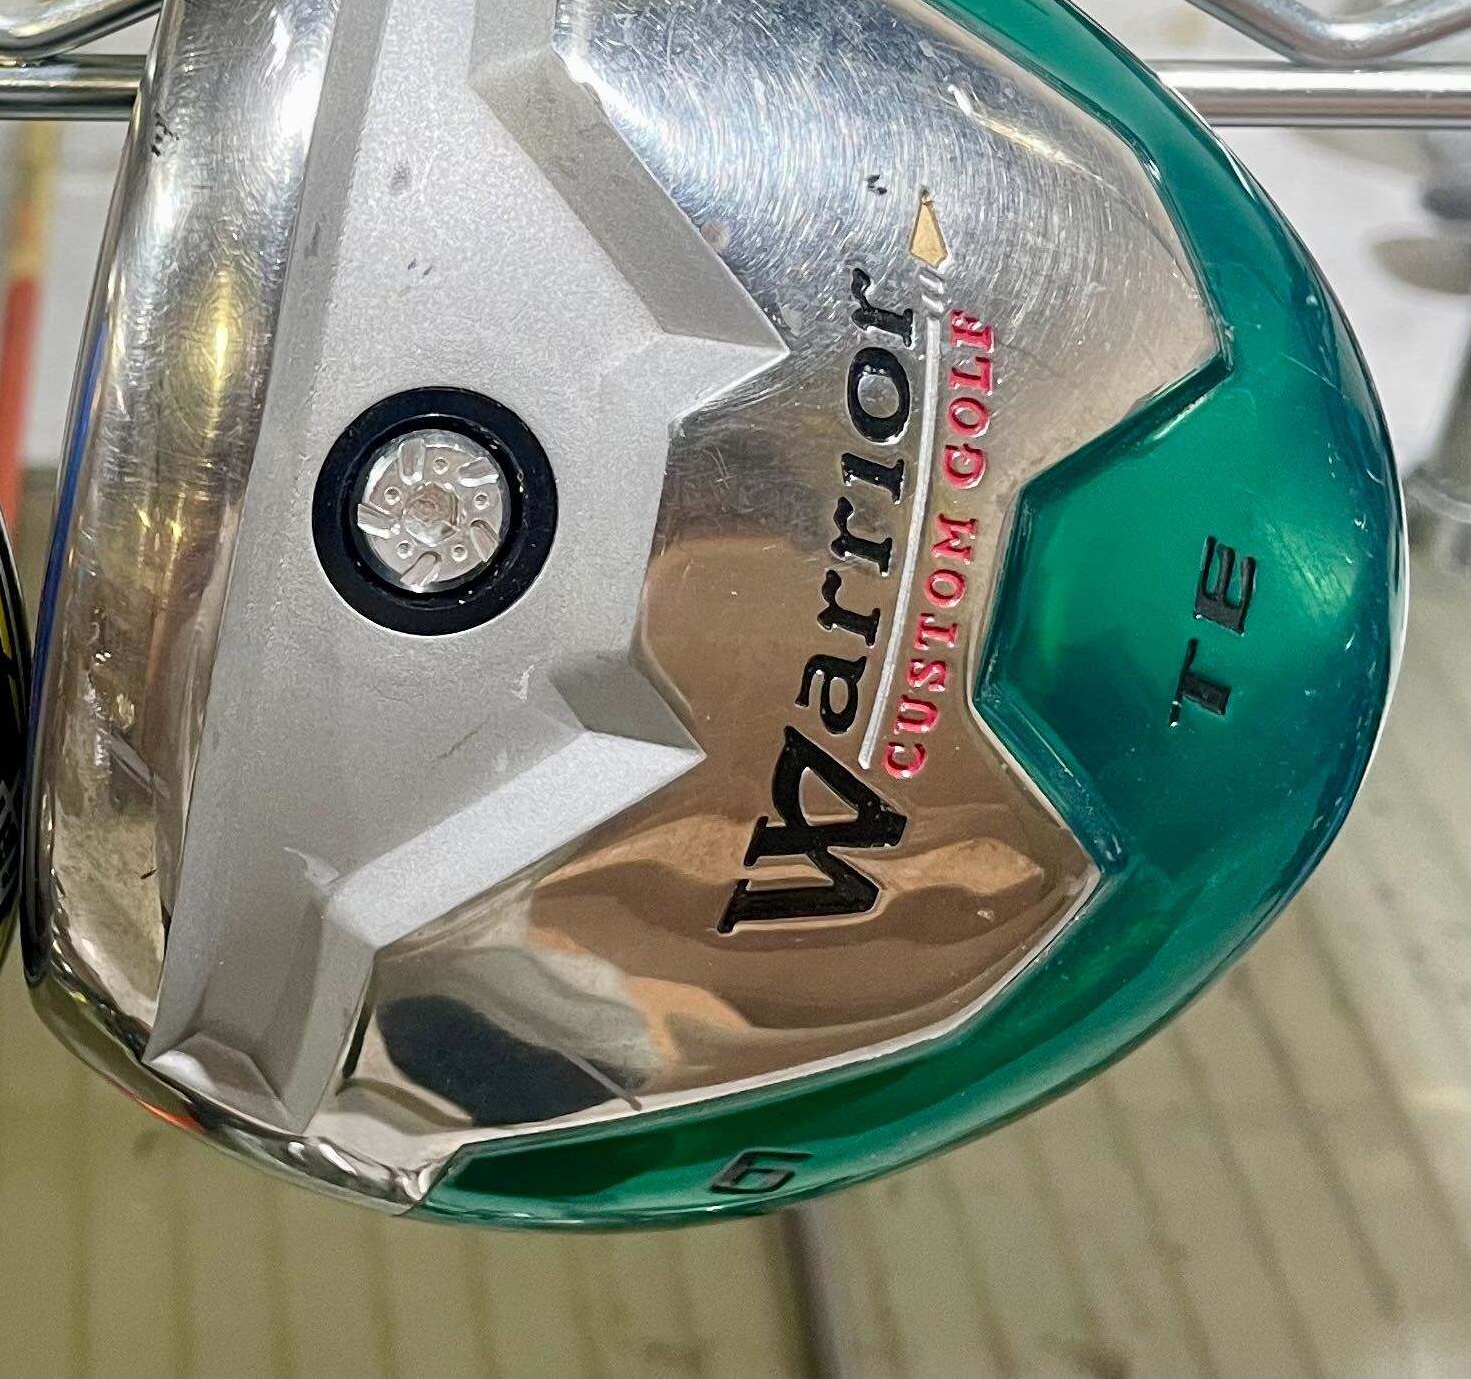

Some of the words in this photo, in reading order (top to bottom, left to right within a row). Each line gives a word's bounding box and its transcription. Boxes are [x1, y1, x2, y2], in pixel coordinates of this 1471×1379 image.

[715, 266, 917, 935] Warrior
[883, 516, 978, 780] CUSTOM
[940, 308, 997, 491] GOLF
